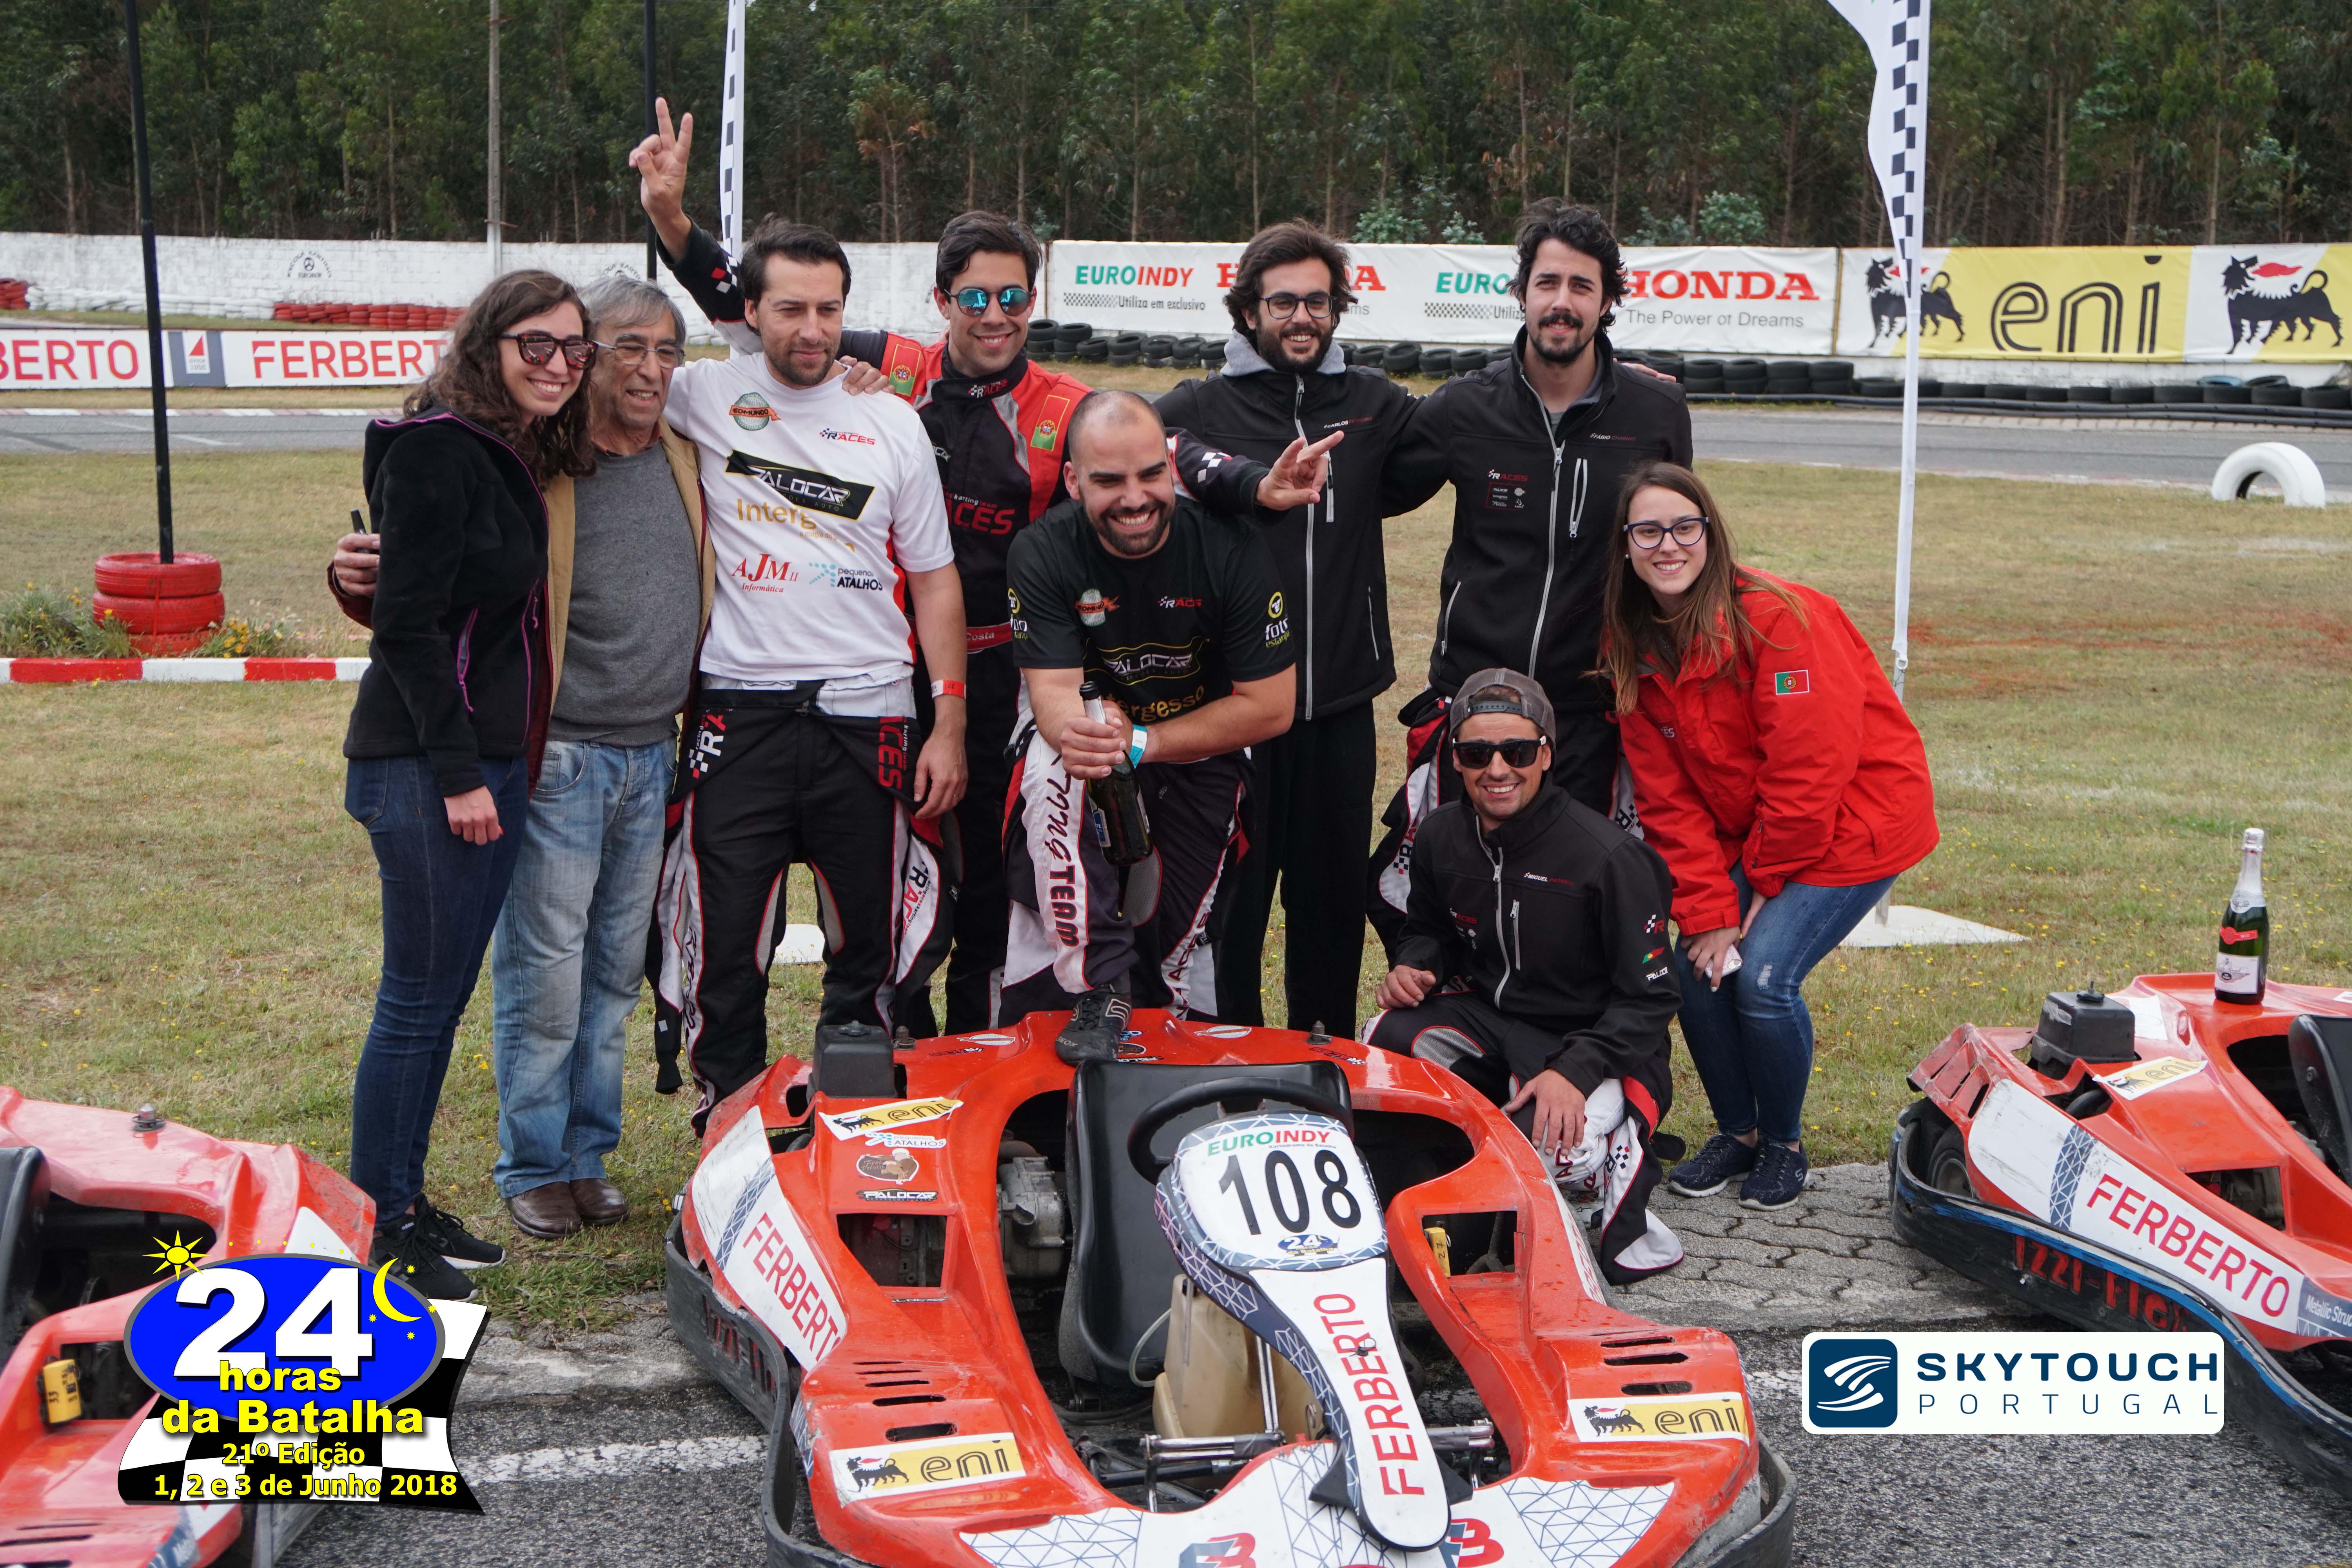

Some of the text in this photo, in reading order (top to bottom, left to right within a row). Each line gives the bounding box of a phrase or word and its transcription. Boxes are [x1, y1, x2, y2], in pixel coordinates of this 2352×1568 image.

[1075, 265, 1193, 287] EUROINDY
[1436, 272, 1510, 294] EURO
[1623, 270, 1820, 301] HONDA
[1118, 296, 1205, 311] Utiliza em exclusivo
[1990, 255, 2161, 354] eni
[1626, 310, 1804, 328] The Power of Dreams
[252, 339, 447, 378] FERBERT
[815, 501, 839, 512] AUTO
[954, 494, 979, 506] karting
[731, 553, 792, 581] AJM
[742, 583, 784, 593] Informática
[966, 632, 995, 641] Costa
[695, 726, 704, 750] racing
[1527, 874, 1548, 882] MIGUEL
[1049, 864, 1079, 947] TEAM
[2146, 1059, 2197, 1081] eni
[1207, 1130, 1330, 1156] EUROINDY
[1219, 1149, 1361, 1235] 108
[1284, 1235, 1322, 1250] 24
[2087, 1174, 2289, 1317] FERBERTO
[2305, 1294, 2332, 1320] Metallic
[1314, 1294, 1425, 1496] FERBERTO
[1654, 1399, 1739, 1434] eni
[920, 1439, 1010, 1482] eni
